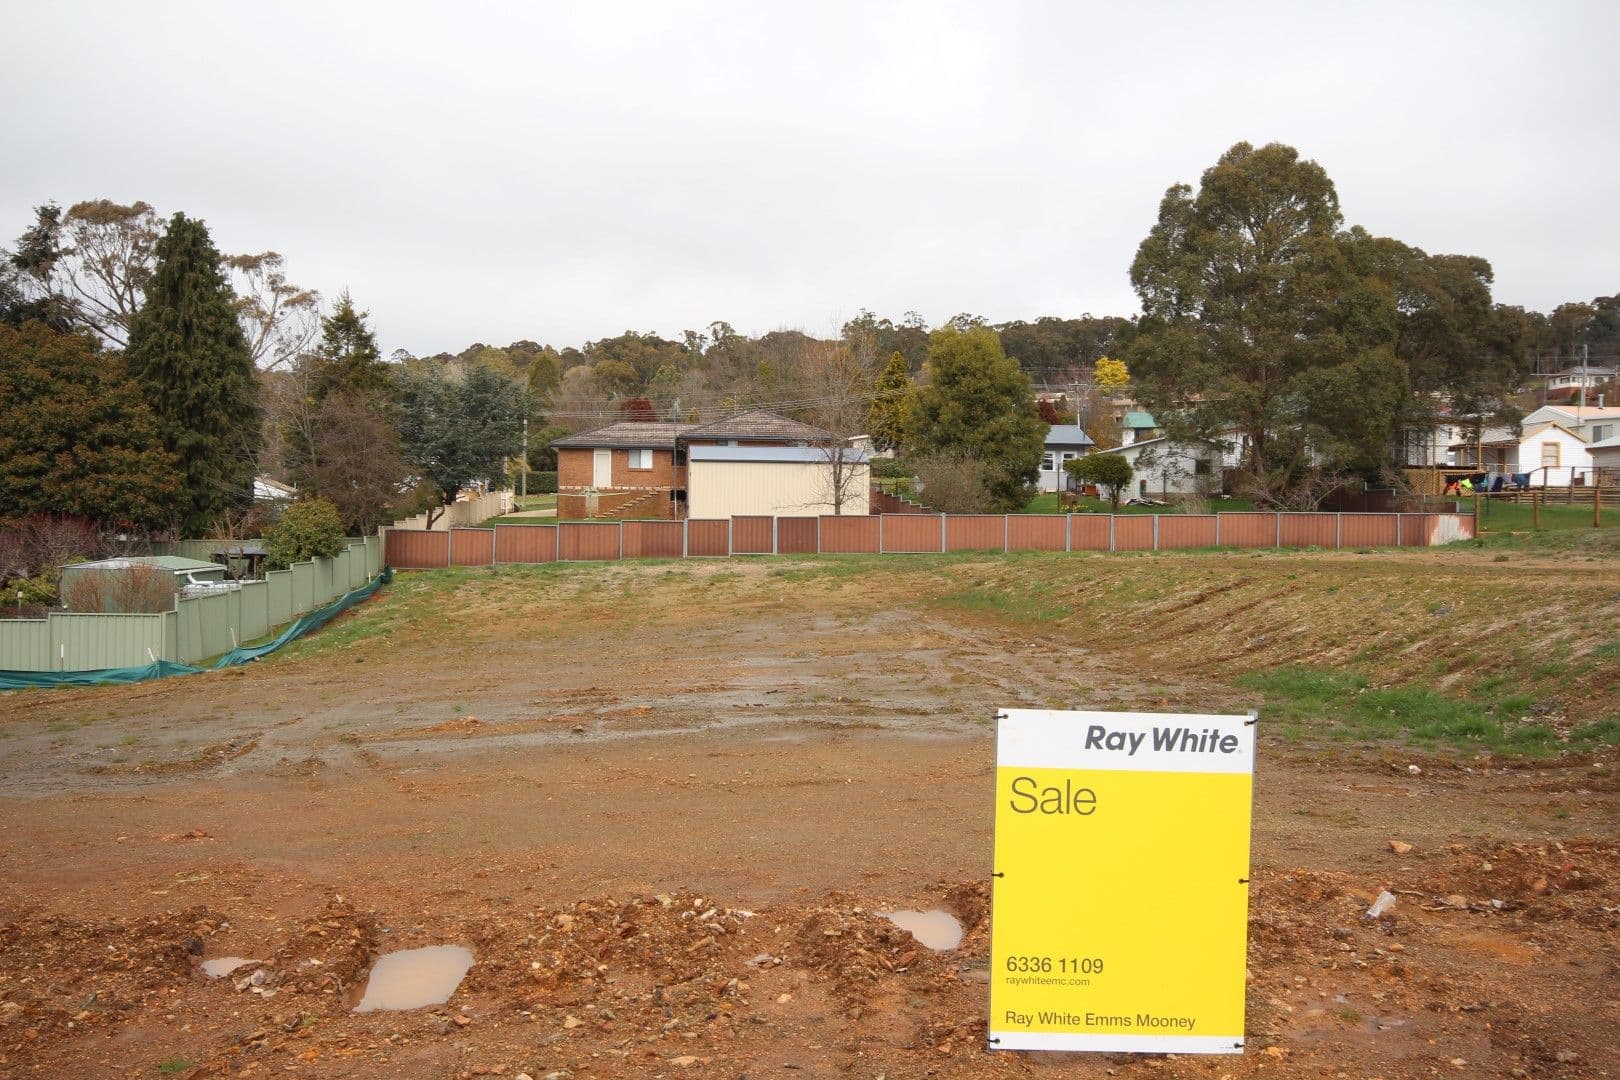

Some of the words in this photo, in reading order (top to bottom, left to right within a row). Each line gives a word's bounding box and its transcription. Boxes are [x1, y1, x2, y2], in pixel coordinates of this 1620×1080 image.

[1085, 725, 1146, 756] Ray
[1152, 727, 1239, 754] White
[1010, 777, 1097, 815] Sale
[1006, 956, 1052, 973] 6336
[1059, 957, 1104, 974] 1109
[1006, 976, 1090, 987] raywhiteemc.com
[1005, 1011, 1034, 1027] Ray
[1038, 1012, 1081, 1026] White
[1085, 1013, 1132, 1027] Emms
[1136, 1014, 1196, 1031] Mooney
